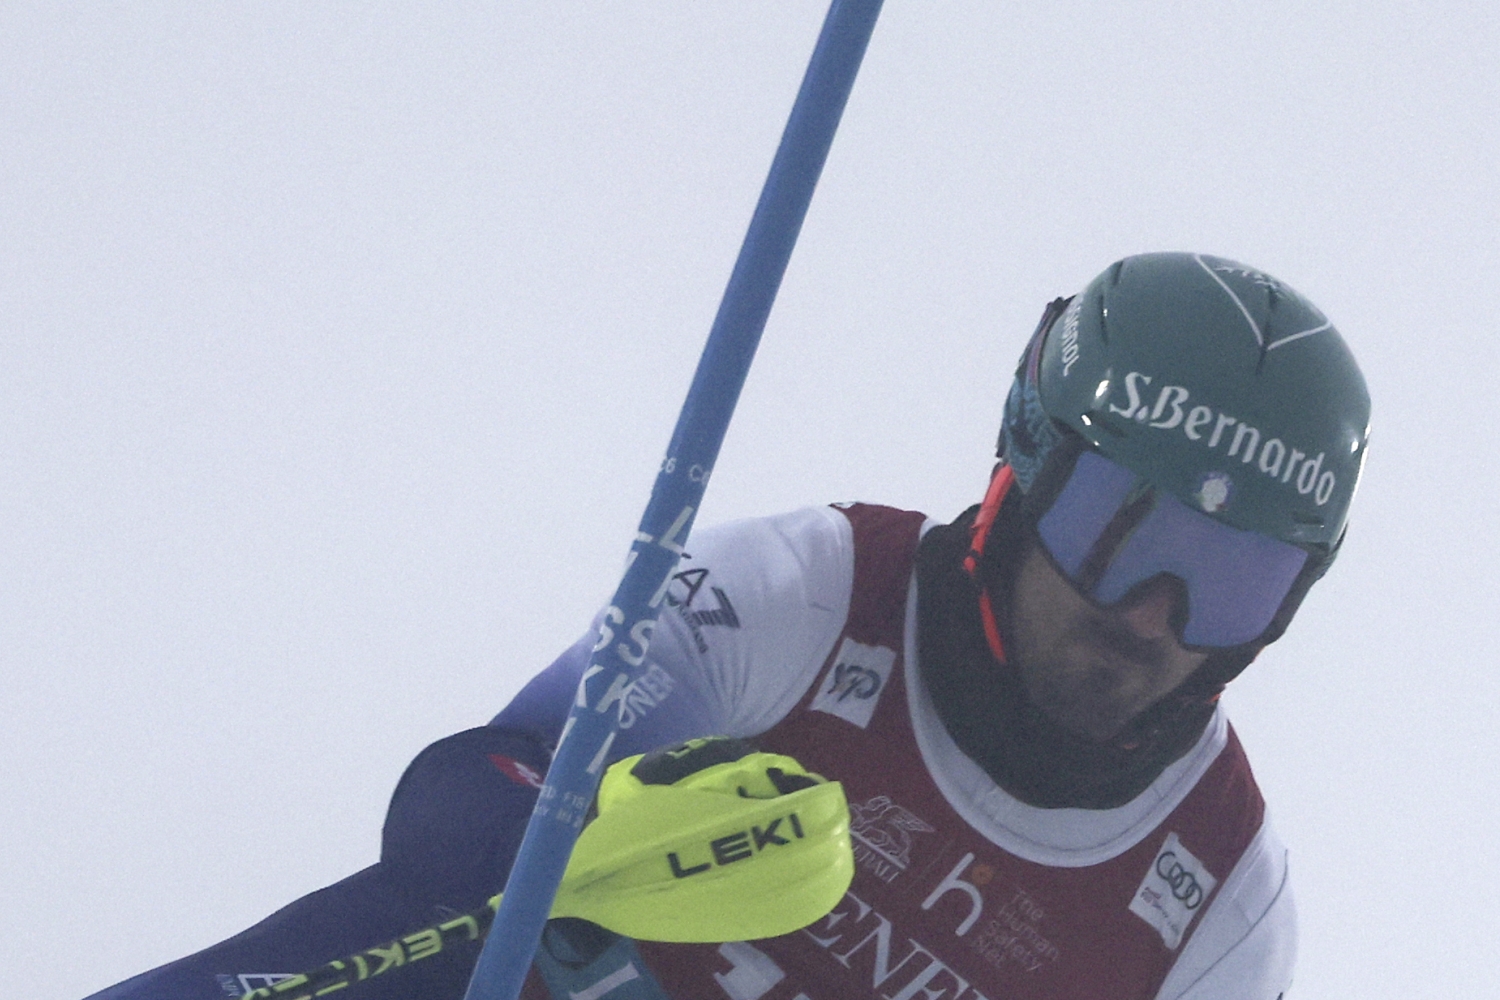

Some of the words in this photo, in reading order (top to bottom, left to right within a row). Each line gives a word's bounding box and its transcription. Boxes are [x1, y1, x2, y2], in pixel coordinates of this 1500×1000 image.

[1110, 371, 1336, 506] S.Bernardo
[667, 813, 806, 879] LEKI
[353, 914, 480, 982] LEKI
